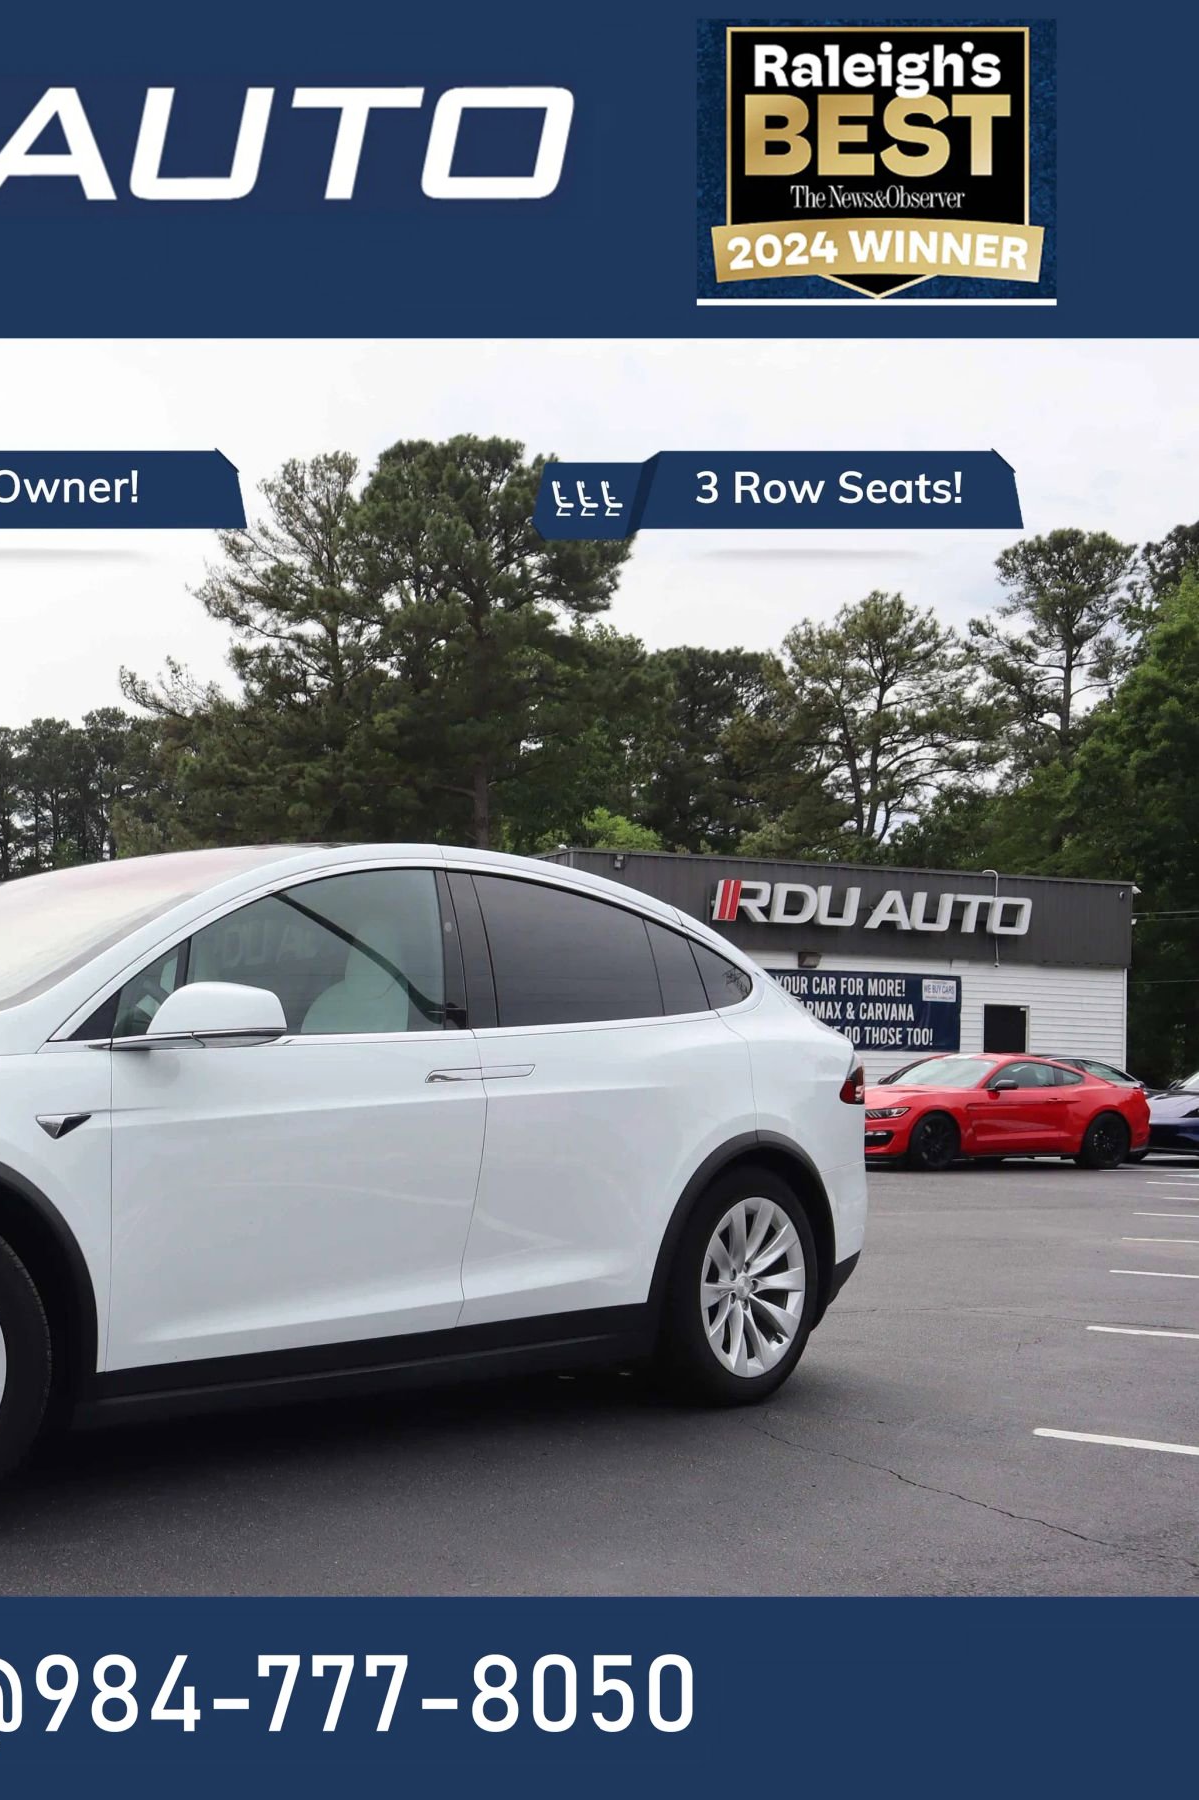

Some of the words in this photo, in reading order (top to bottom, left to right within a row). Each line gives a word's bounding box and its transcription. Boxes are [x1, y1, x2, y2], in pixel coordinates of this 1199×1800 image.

[739, 880, 861, 926] RDU
[864, 890, 1032, 935] AUTO
[812, 976, 837, 995] CAR
[841, 977, 864, 996] FOR
[867, 978, 906, 997] MORE!
[801, 1001, 842, 1019] RMAX
[846, 1001, 855, 1020] &
[859, 1002, 915, 1022] CARVANA
[864, 1026, 902, 1045] THOSE
[906, 1028, 933, 1046] TOO!
